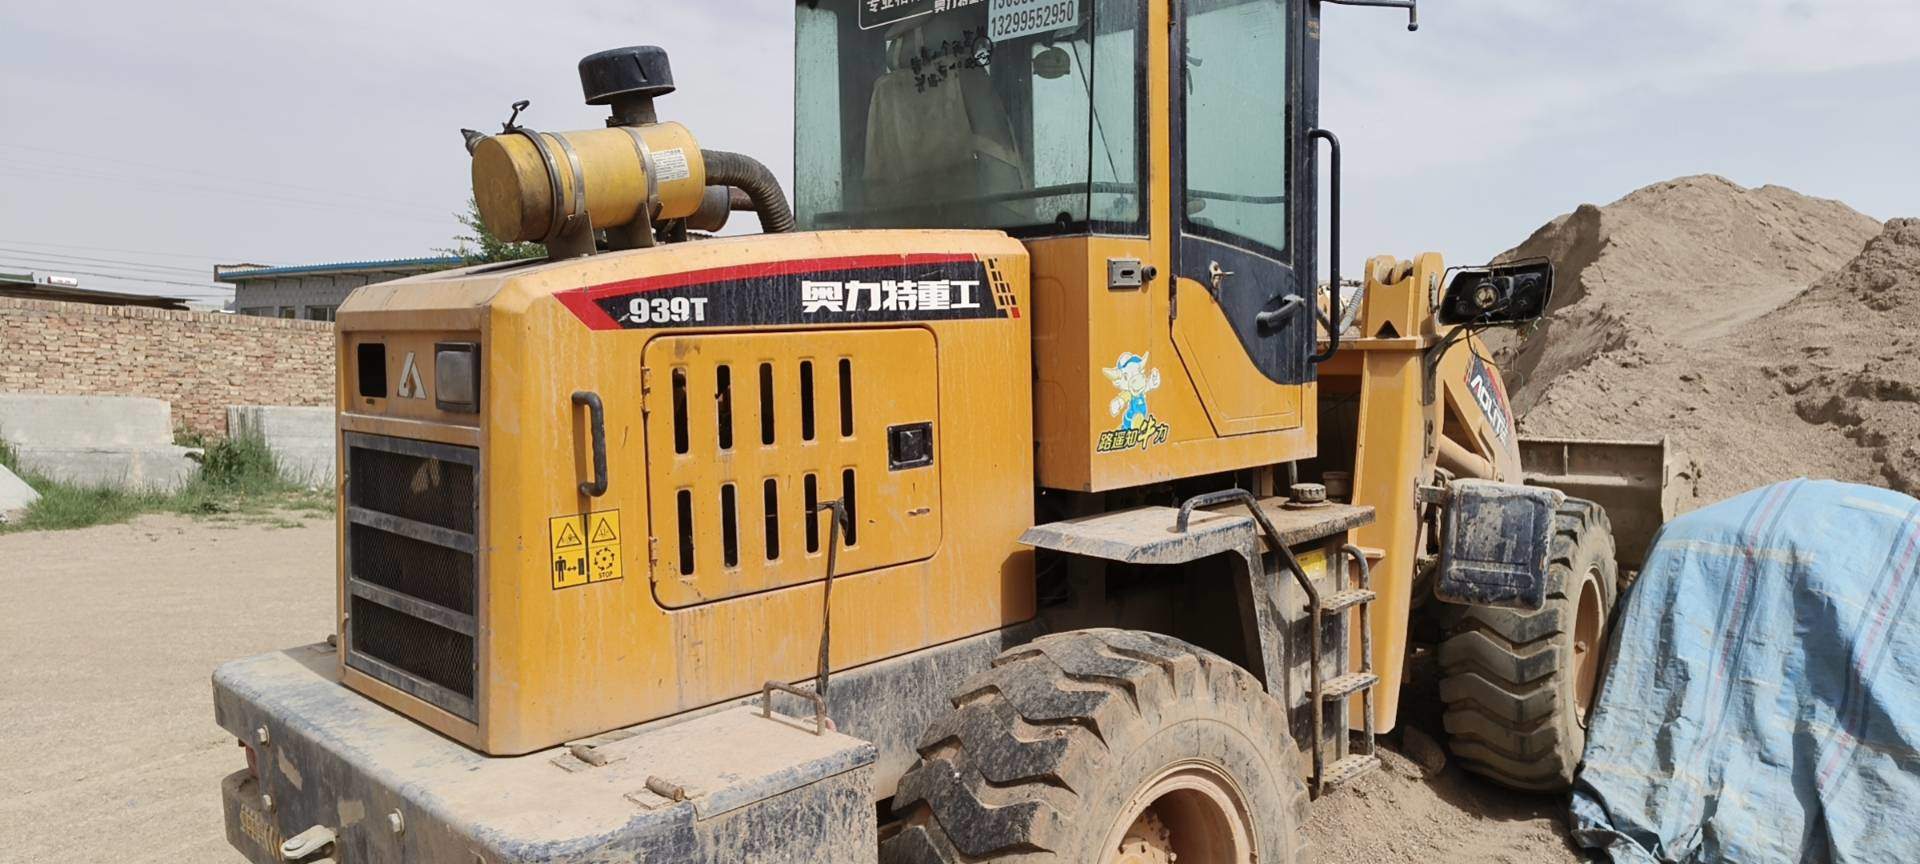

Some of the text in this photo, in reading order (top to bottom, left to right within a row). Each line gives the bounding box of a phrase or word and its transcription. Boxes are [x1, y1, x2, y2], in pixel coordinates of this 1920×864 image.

[991, 0, 1074, 37] 13299552950
[628, 295, 708, 324] 939T
[801, 279, 980, 313] 奥力特重工
[1097, 415, 1169, 452] 路遥知牛力
[598, 570, 614, 580] STOP
